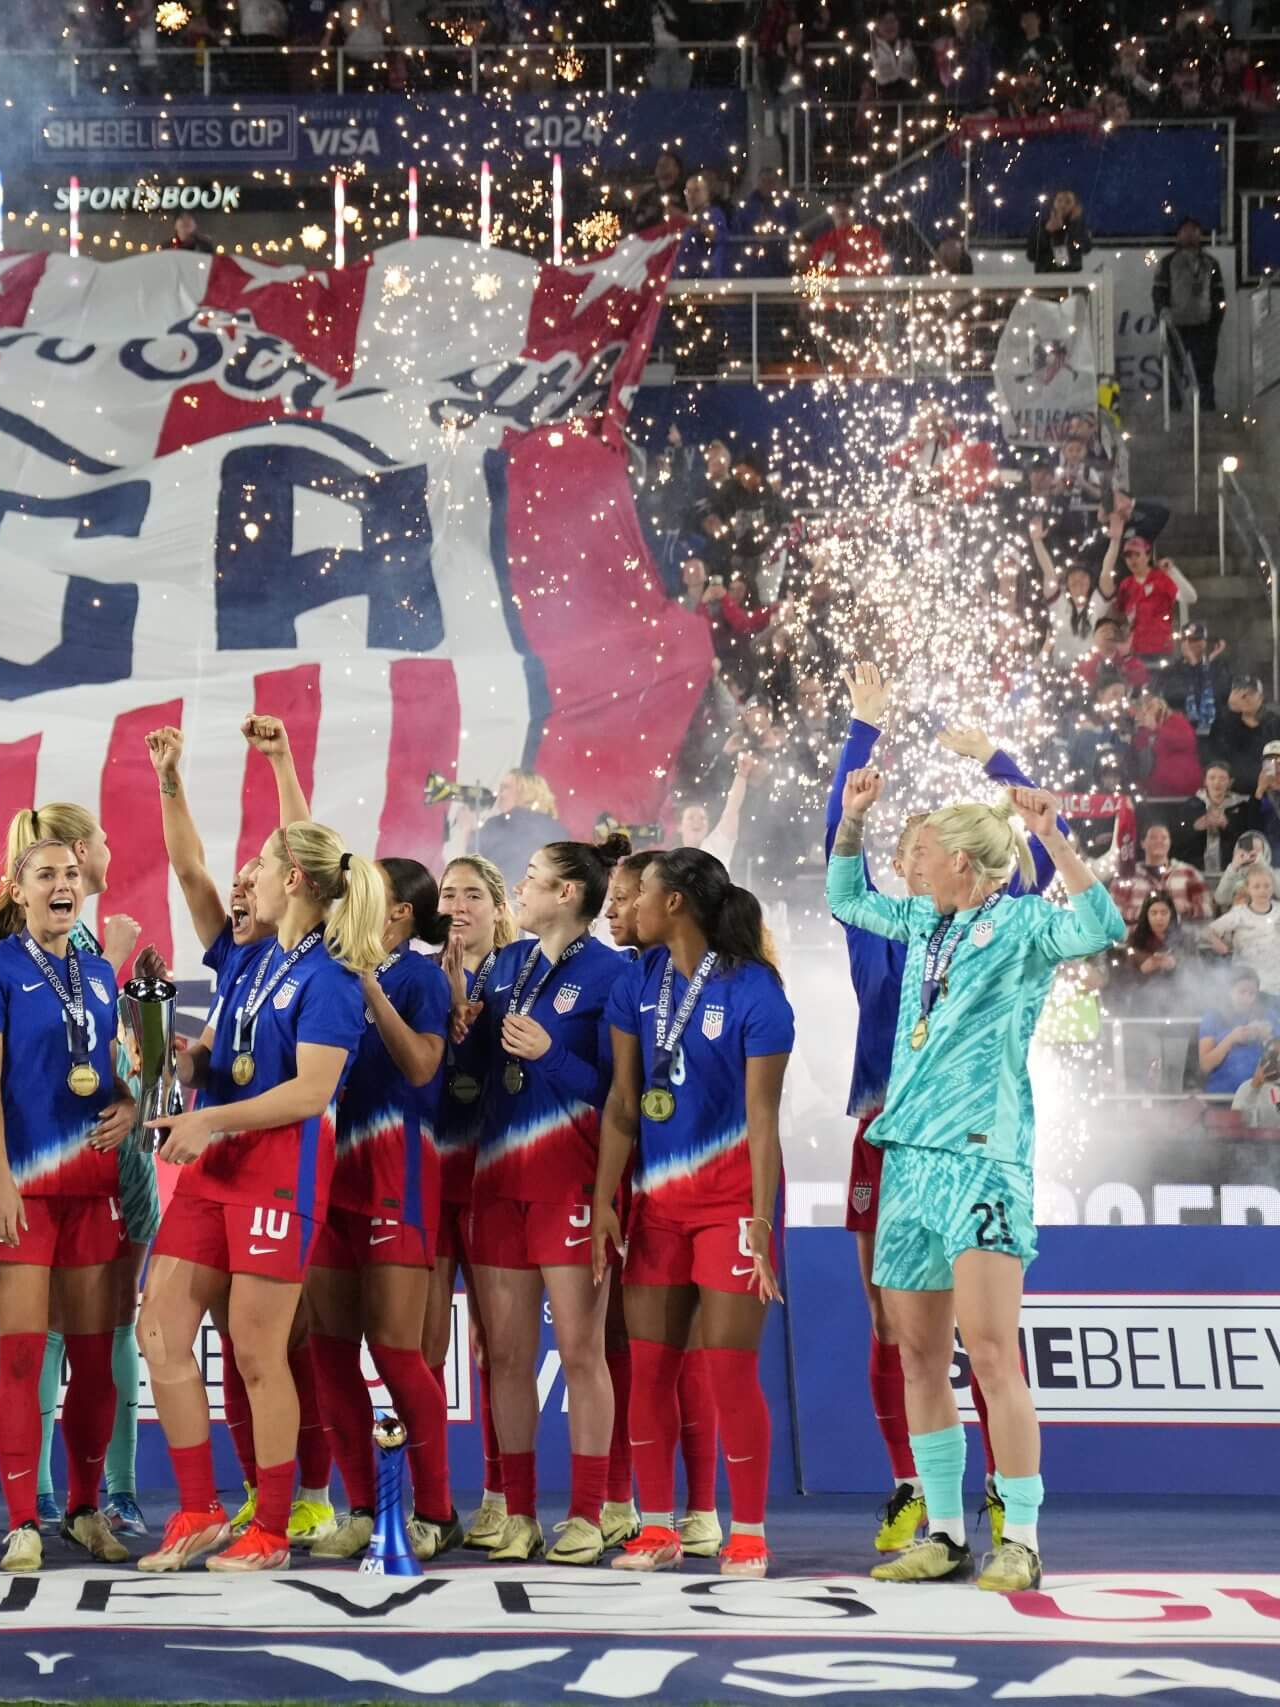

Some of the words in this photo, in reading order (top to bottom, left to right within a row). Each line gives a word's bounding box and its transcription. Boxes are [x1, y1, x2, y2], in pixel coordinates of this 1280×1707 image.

[230, 118, 284, 147] CUP
[304, 128, 380, 155] VISA
[523, 115, 603, 147] 2024
[54, 185, 241, 210] SPORTSBOOK
[297, 931, 322, 954] 2024
[699, 950, 718, 977] 2024
[559, 988, 578, 1001] USA
[655, 1018, 667, 1047] 2024
[249, 1206, 290, 1240] 10
[970, 1201, 1014, 1247] 21
[164, 1642, 1280, 1698] VISA
